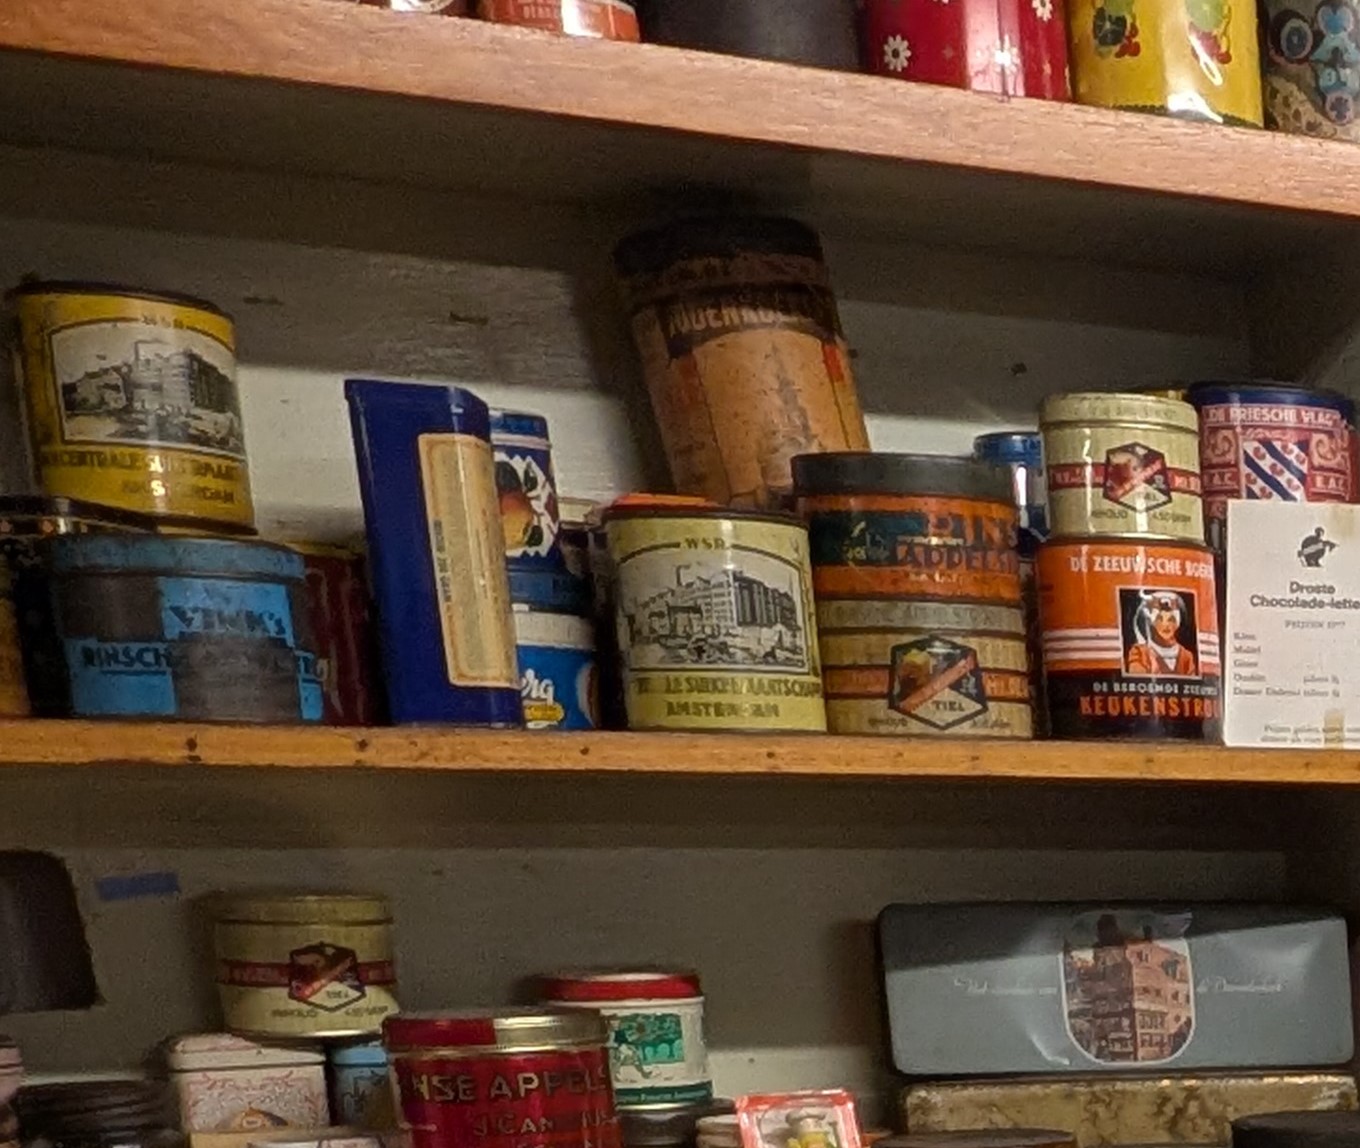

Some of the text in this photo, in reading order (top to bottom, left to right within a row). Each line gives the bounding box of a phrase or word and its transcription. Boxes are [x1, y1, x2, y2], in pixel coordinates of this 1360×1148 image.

[1070, 555, 1088, 572] DE
[1093, 555, 1182, 576] ZEEUWSCHE
[1289, 581, 1336, 594] Droste
[1113, 681, 1179, 695] BEROEMDE
[412, 1072, 476, 1101] NSE
